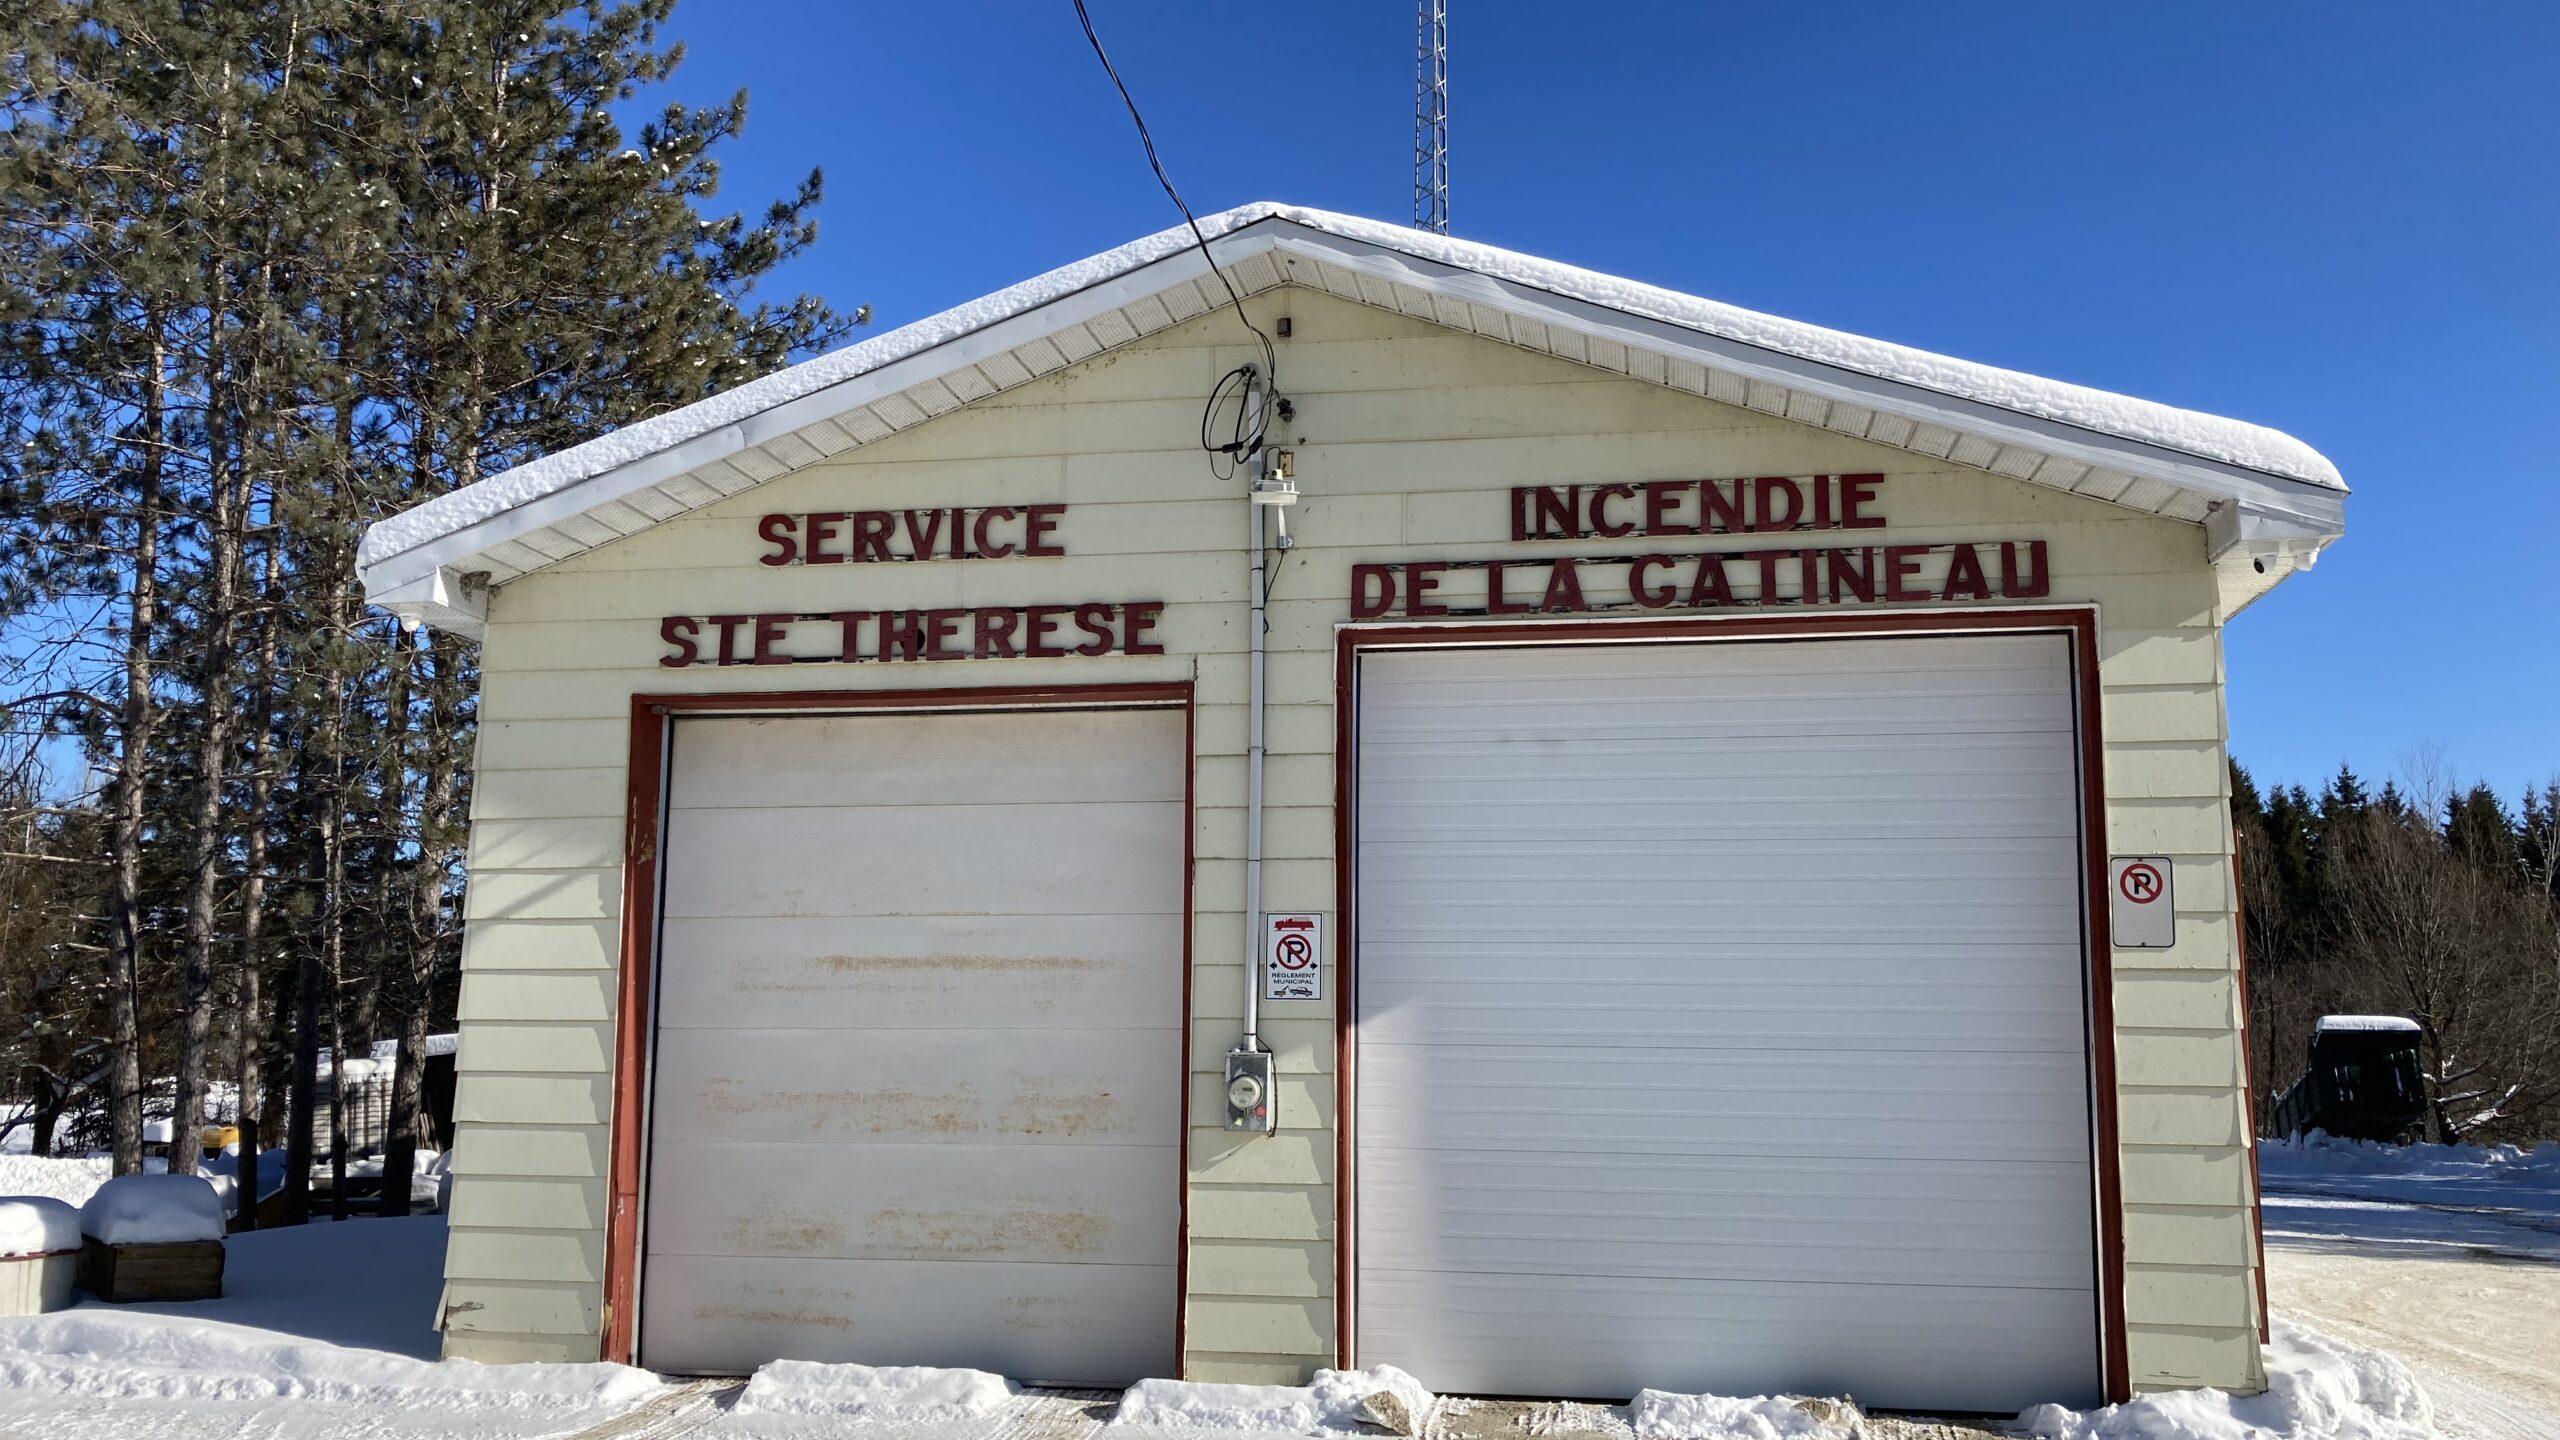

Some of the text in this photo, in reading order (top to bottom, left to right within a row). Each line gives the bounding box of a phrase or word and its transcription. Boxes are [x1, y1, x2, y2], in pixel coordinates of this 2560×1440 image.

[758, 504, 1066, 567] SERVICE
[1511, 473, 1887, 541] INCENDIE
[1350, 540, 2050, 619] DE LA GATINEAU
[659, 601, 1165, 668] STE THERESE
